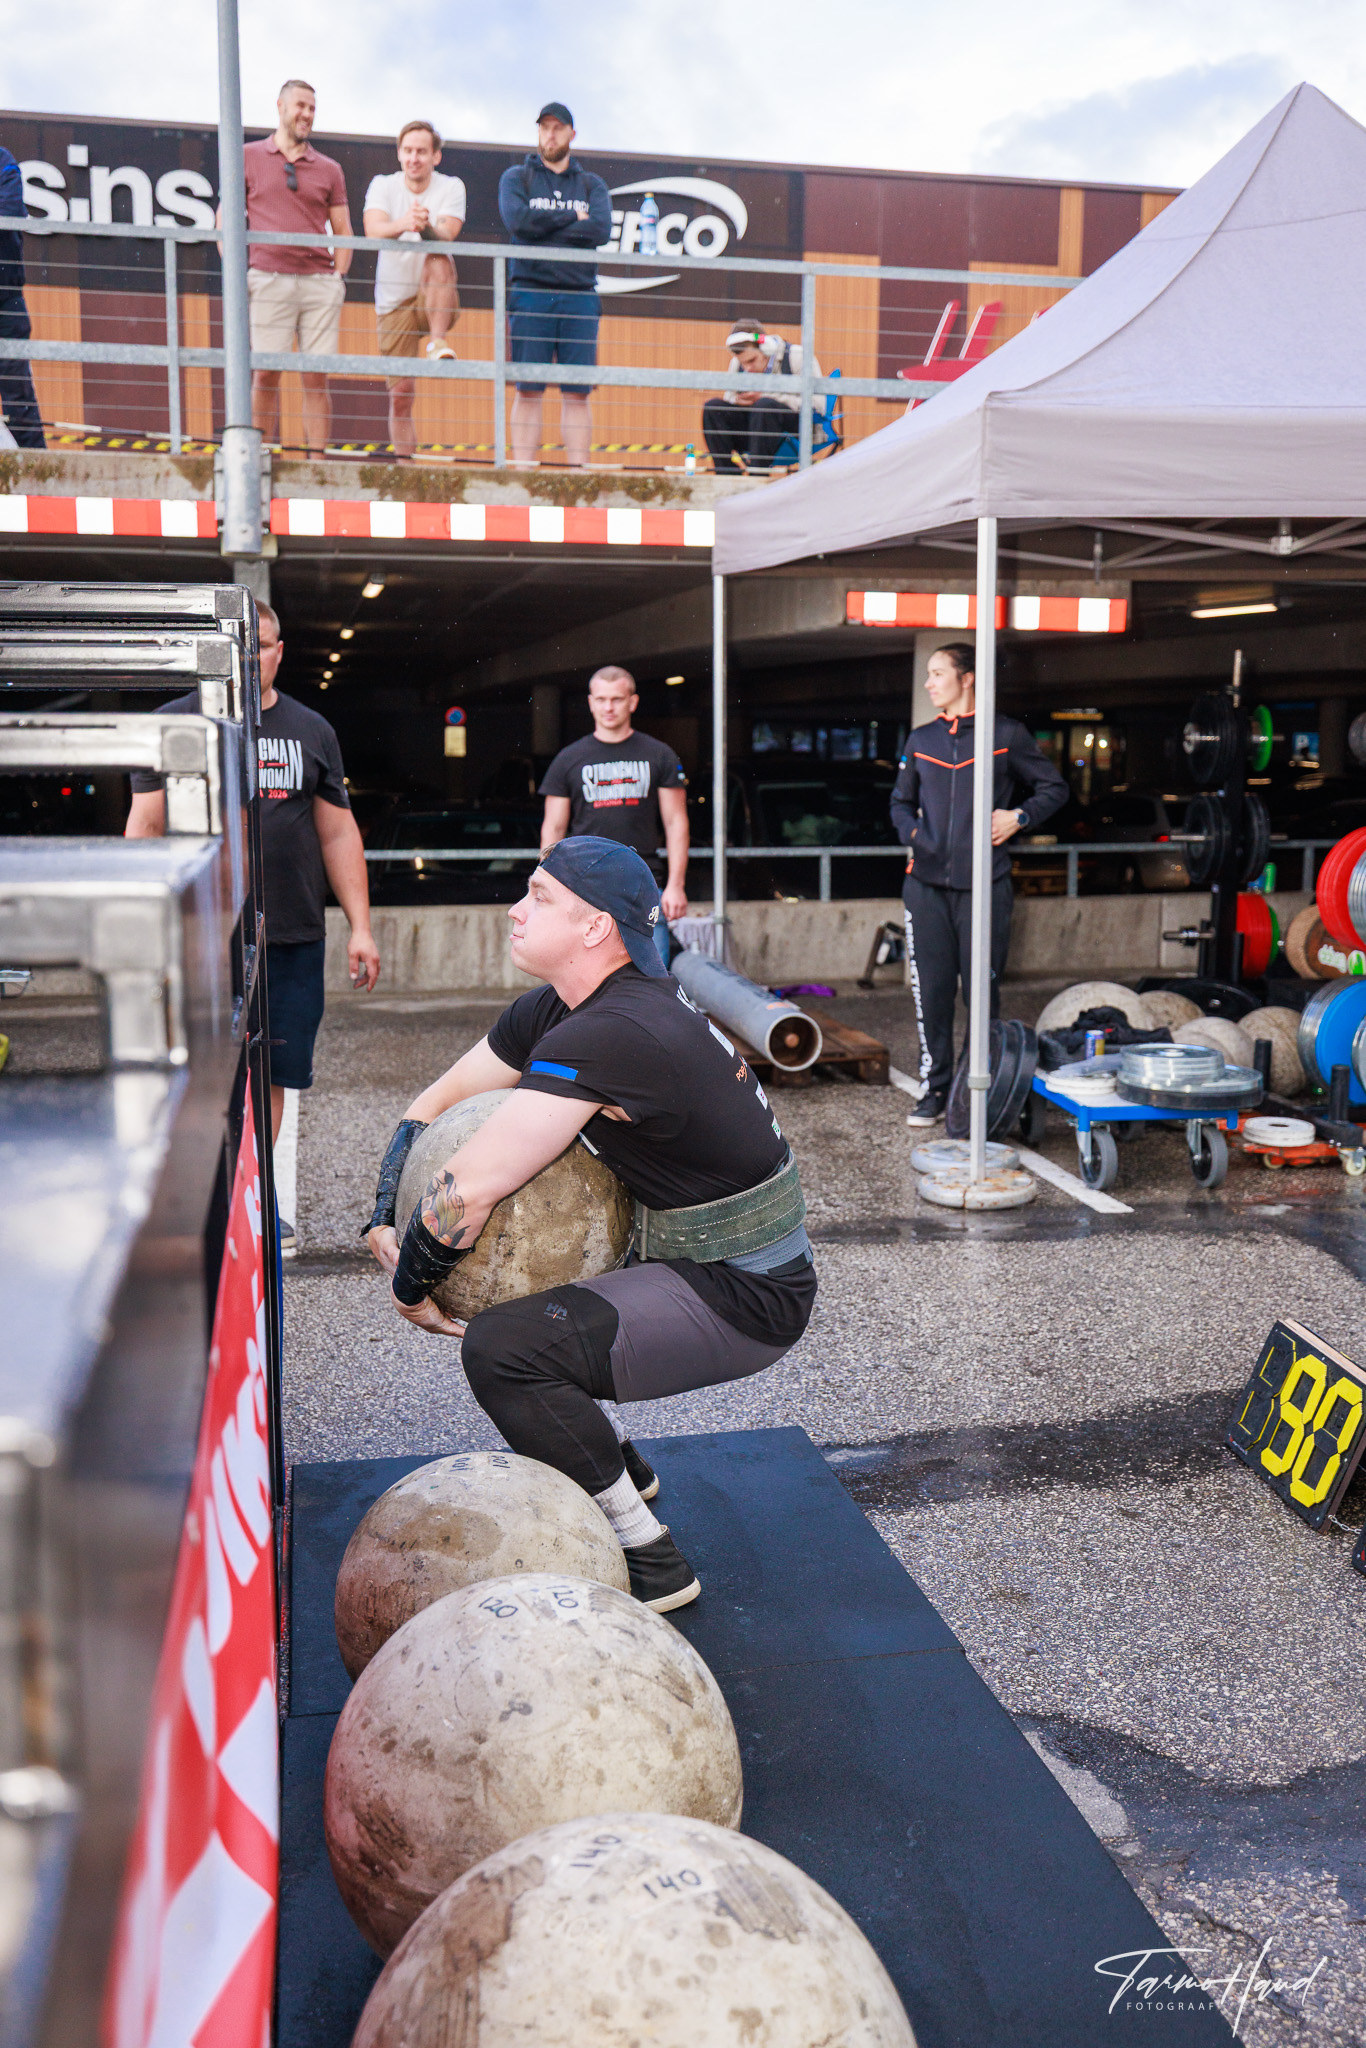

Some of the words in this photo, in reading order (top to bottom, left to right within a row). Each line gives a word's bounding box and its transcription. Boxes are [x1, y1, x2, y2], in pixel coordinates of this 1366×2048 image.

[268, 789, 288, 799] 2026
[478, 1596, 519, 1618] 120
[545, 1585, 579, 1609] 120
[569, 1834, 622, 1868] 140
[643, 1869, 702, 1899] 140
